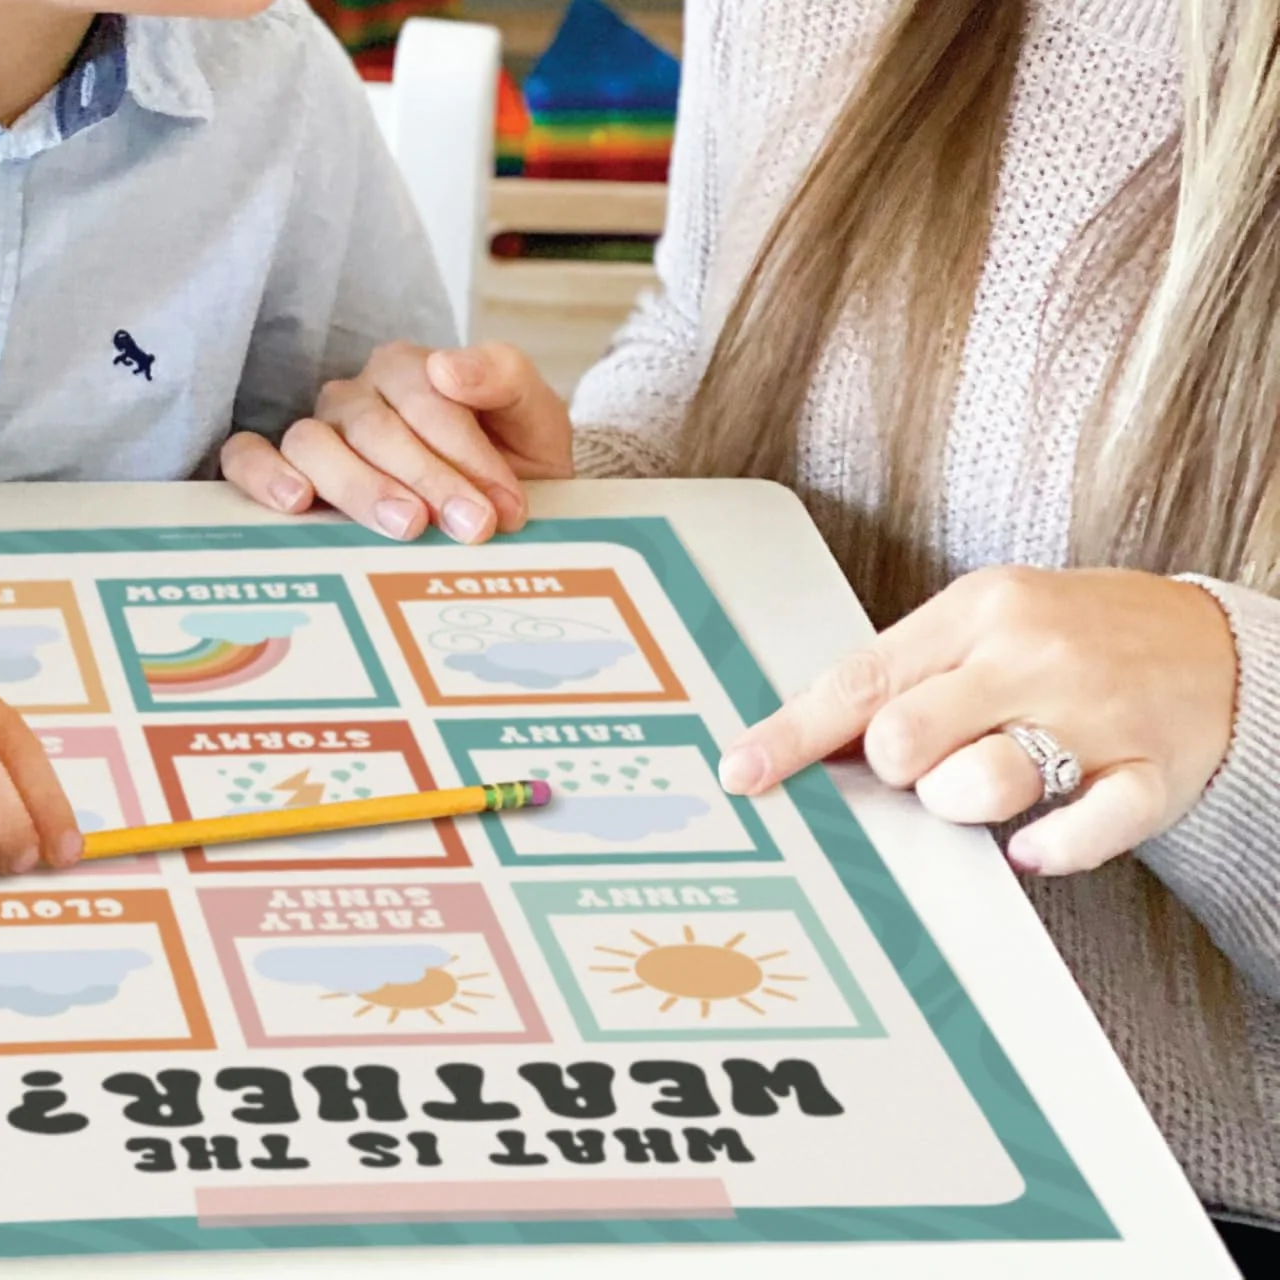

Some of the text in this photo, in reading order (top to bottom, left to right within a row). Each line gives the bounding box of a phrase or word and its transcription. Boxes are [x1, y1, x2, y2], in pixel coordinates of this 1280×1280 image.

[124, 581, 320, 603] RAINBOW
[425, 575, 565, 595] WINDY
[189, 729, 372, 751] STORMY
[499, 723, 646, 744] RAINY
[267, 887, 432, 909] SUNNY
[576, 885, 741, 908] SUNNY
[259, 909, 445, 931] PARTLY
[7, 1058, 845, 1135] WEATHER?
[125, 1127, 755, 1172] WHAT IS THE
